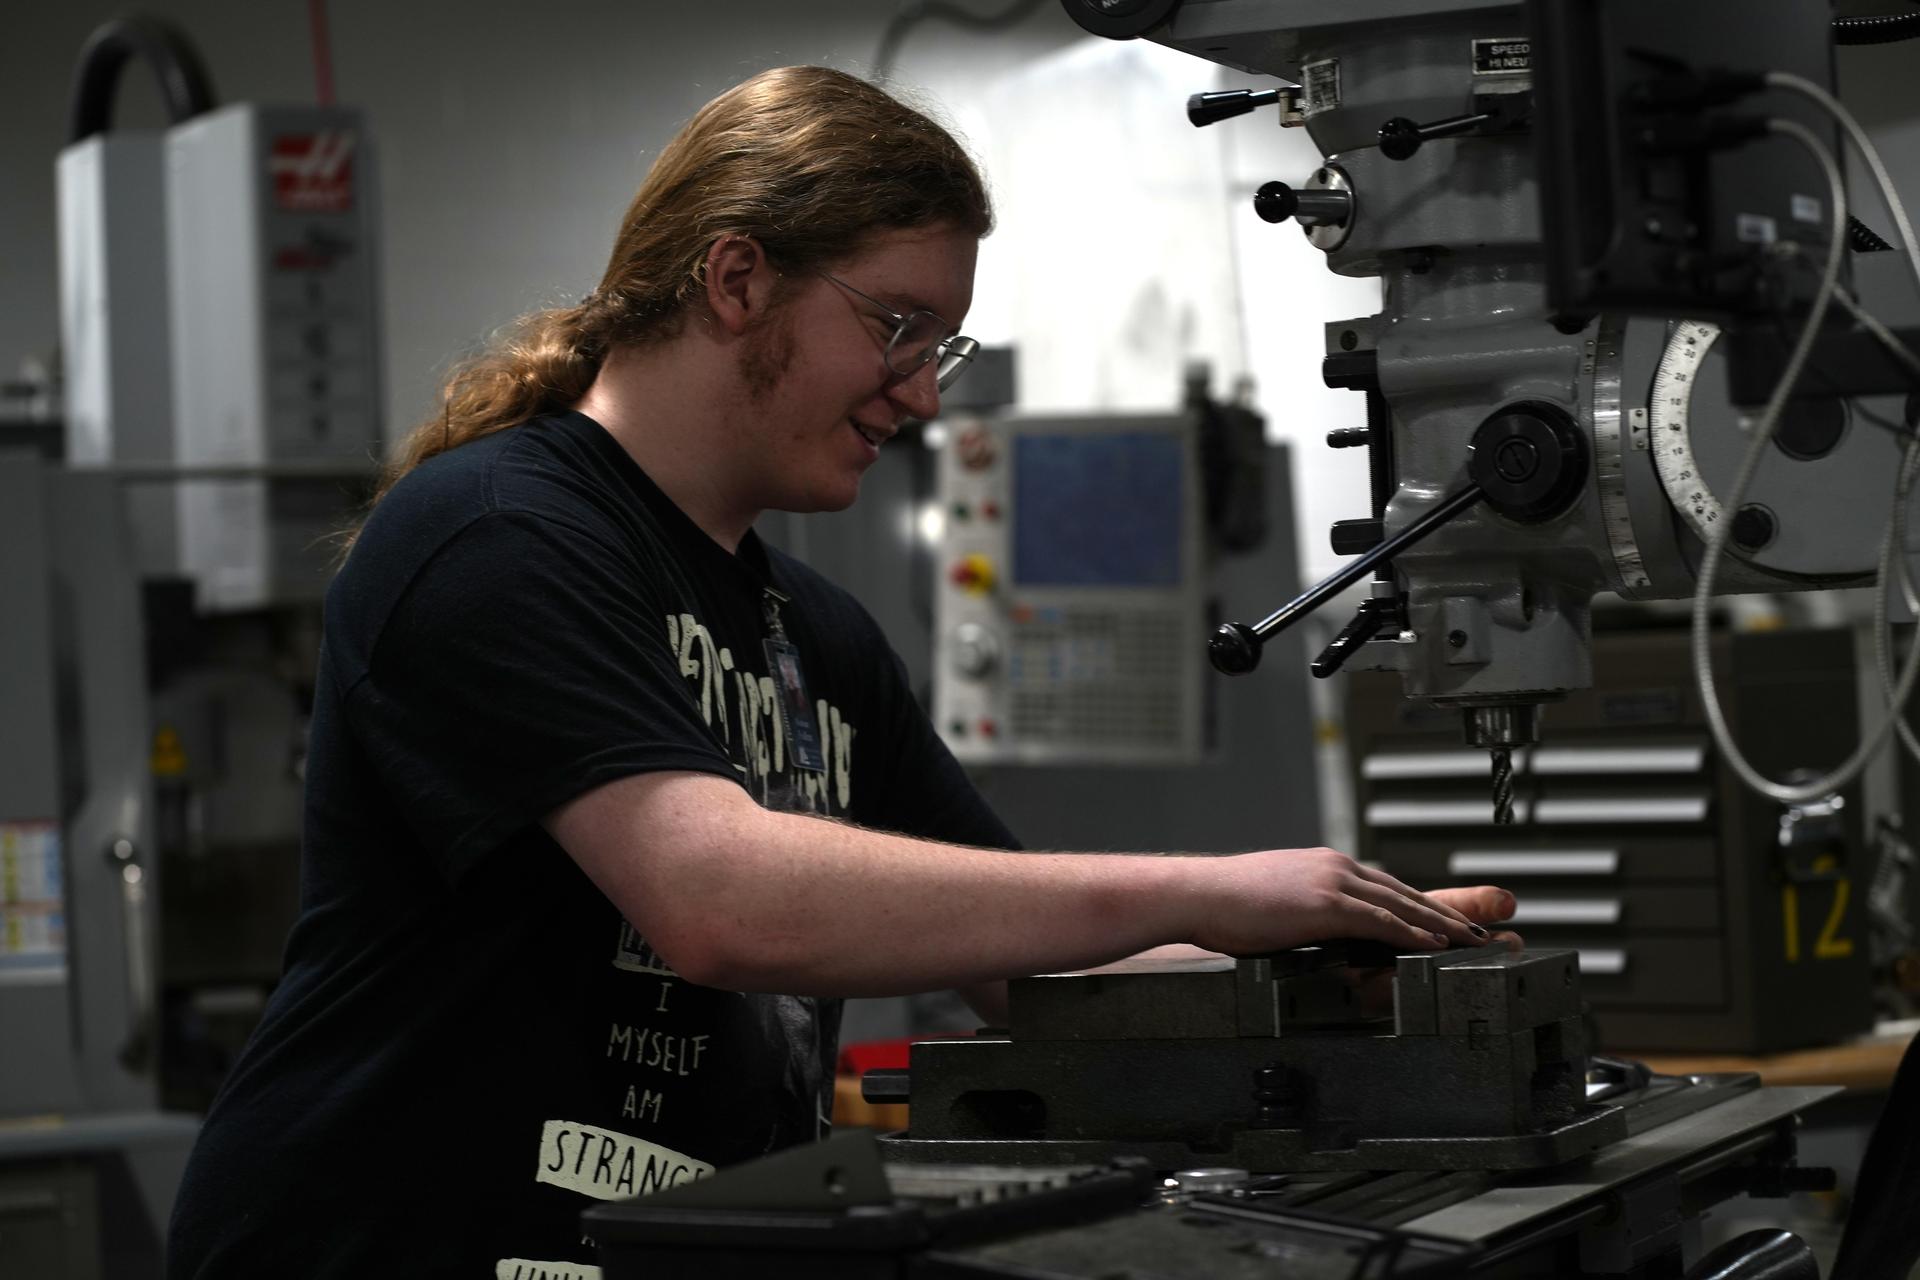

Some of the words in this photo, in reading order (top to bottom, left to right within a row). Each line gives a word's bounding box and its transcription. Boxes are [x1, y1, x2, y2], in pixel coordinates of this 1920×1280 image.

[1491, 44, 1530, 54] SPEED
[1781, 854, 1854, 962] 12
[655, 981, 673, 1013] I
[606, 1022, 711, 1077] MYSELF
[621, 1083, 665, 1124] AM
[548, 1129, 705, 1197] STRANG
